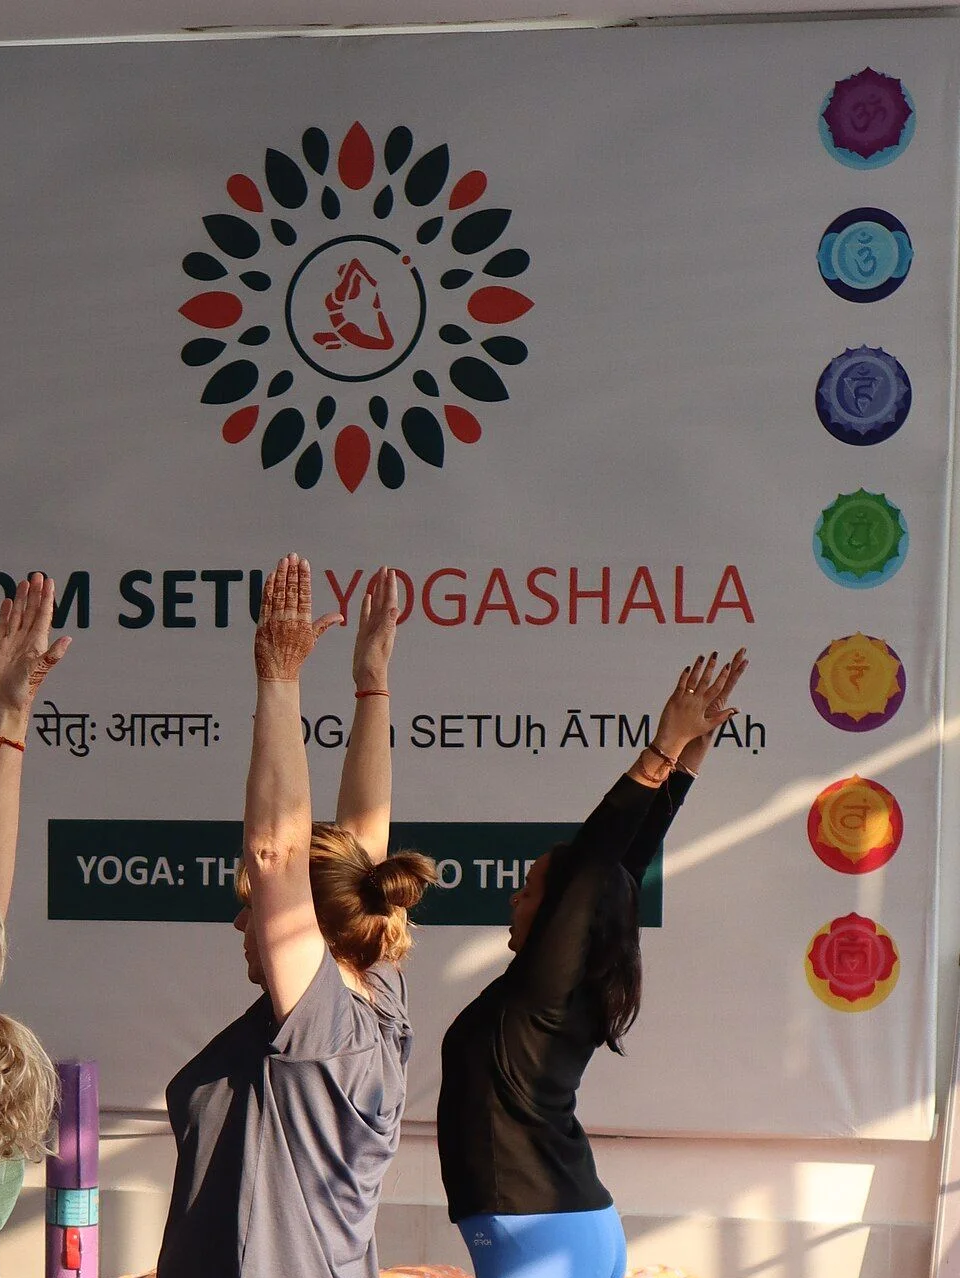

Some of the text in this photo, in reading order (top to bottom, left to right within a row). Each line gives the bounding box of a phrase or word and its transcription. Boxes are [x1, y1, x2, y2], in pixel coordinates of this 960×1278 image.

[324, 564, 756, 627] YOGASHALA
[76, 855, 185, 886] YOGA:
[195, 856, 241, 887] TH
